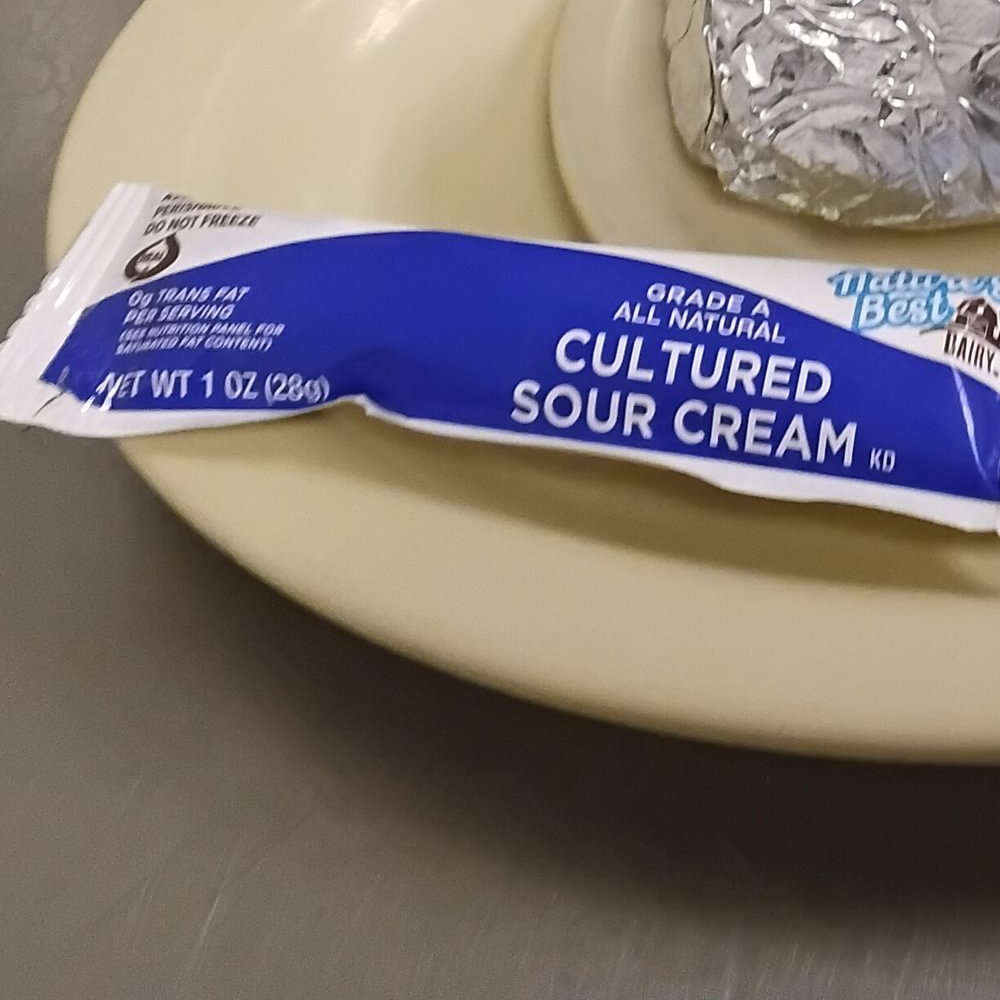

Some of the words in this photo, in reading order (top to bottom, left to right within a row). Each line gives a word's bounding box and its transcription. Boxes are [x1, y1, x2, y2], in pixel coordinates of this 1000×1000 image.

[143, 222, 163, 237] DO
[166, 216, 200, 231] NOT
[200, 214, 262, 228] FREEZE
[157, 287, 210, 302] TRANS
[213, 286, 250, 301] FAT
[646, 282, 745, 315] GRADE
[750, 299, 771, 318] A
[850, 282, 955, 333] Best
[123, 307, 157, 325] PER
[158, 304, 236, 321] SERVING
[148, 323, 209, 338] NUTRITION
[210, 323, 254, 336] PANEL
[255, 323, 285, 338] FOR
[612, 301, 661, 326] ALL
[668, 305, 786, 344] NATURAL
[179, 335, 205, 349] FAT
[204, 335, 273, 351] CONTENT)
[554, 328, 832, 405] CULTURED
[98, 369, 146, 399] NET
[151, 369, 193, 399] WT
[202, 371, 214, 399] 1
[224, 370, 258, 400] OZ
[265, 372, 330, 406] (28g)
[510, 379, 656, 440] SOUR
[673, 399, 857, 468] CREAM
[869, 447, 896, 474] KD
